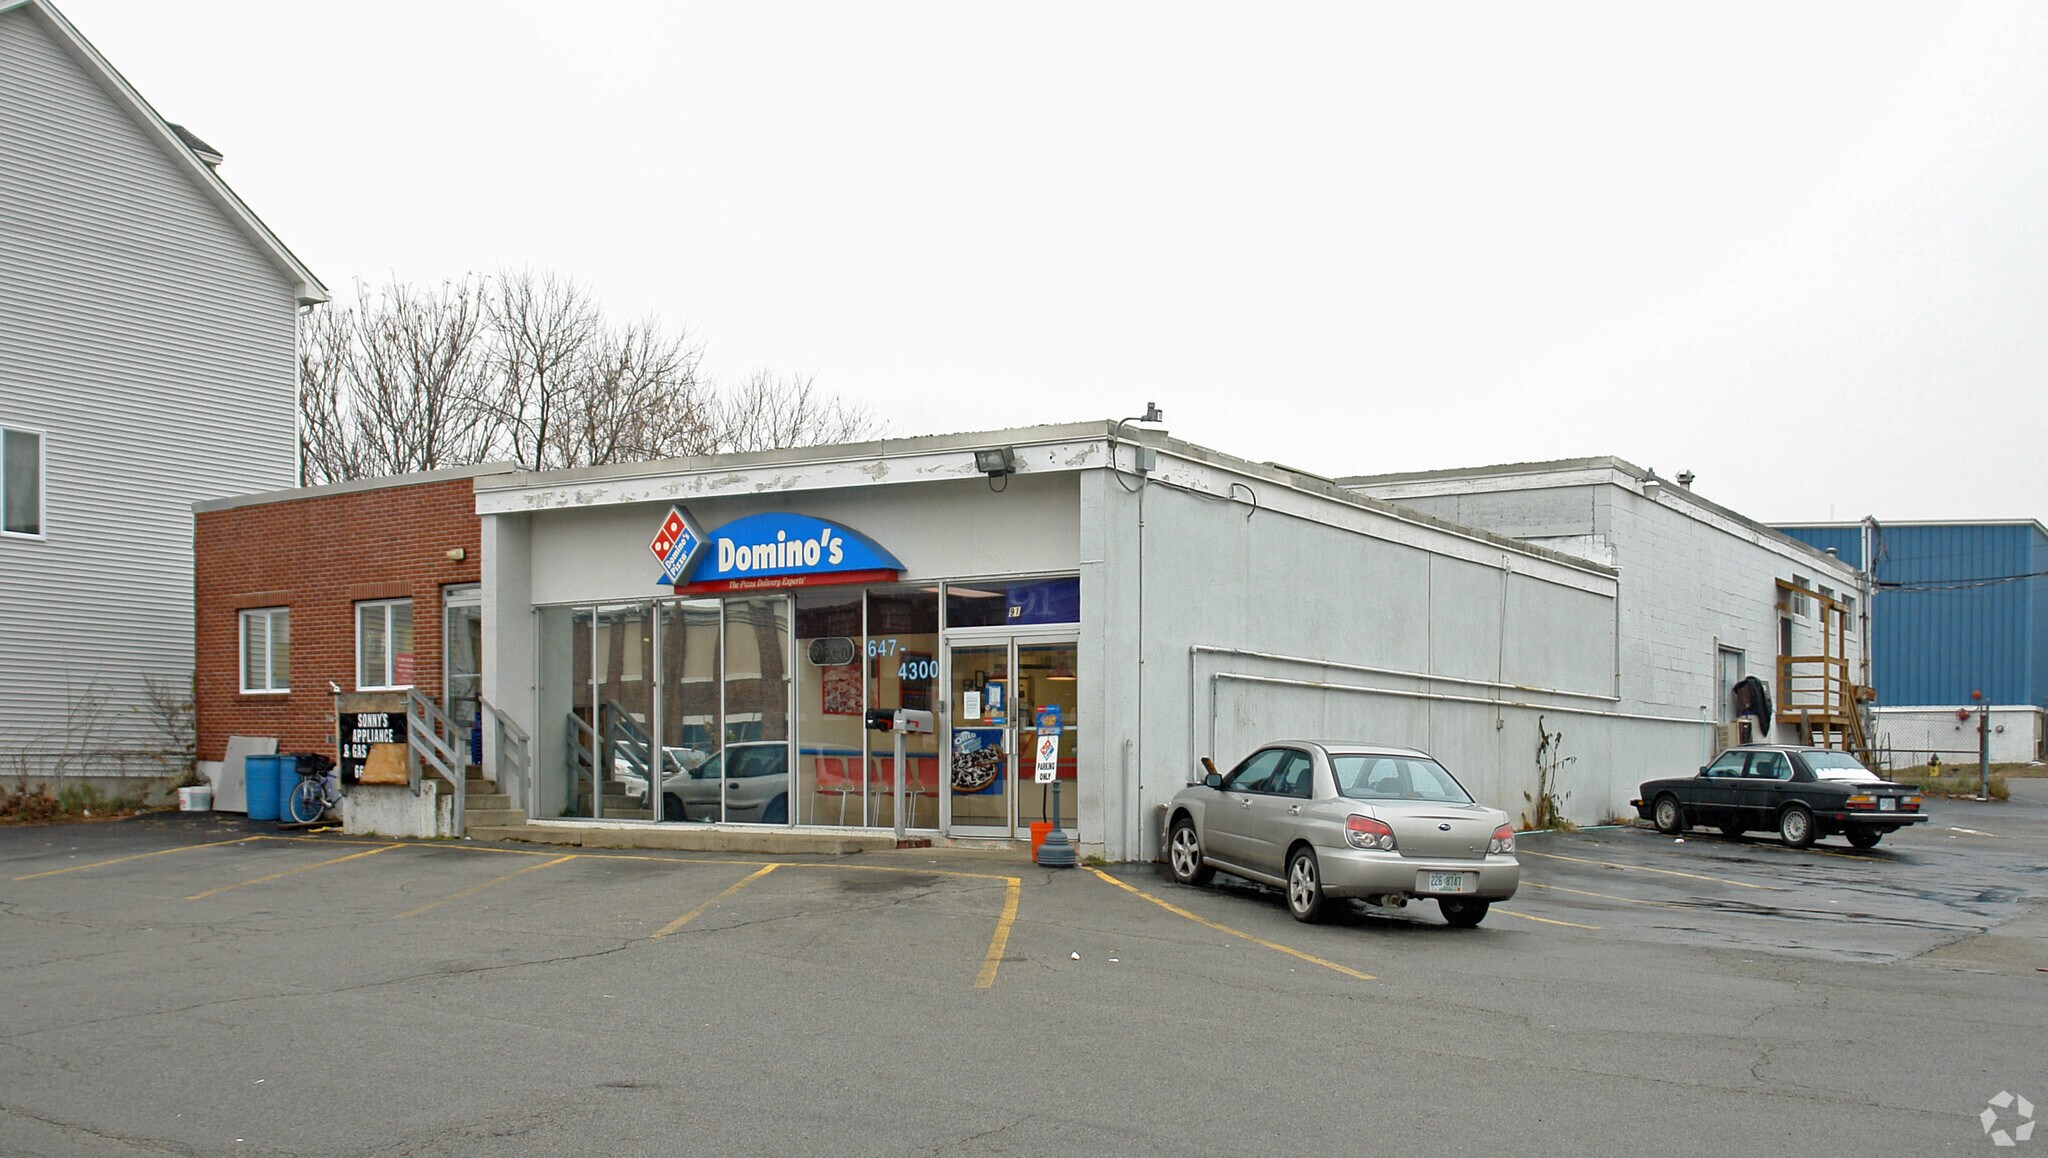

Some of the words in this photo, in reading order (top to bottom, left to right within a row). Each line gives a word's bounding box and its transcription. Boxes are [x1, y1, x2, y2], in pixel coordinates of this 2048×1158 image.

[664, 532, 690, 569] Domino's
[718, 528, 844, 573] Domino's
[670, 552, 687, 576] Pizza
[729, 580, 739, 589] The
[740, 579, 756, 588] Pizza
[757, 578, 781, 587] Delivery
[1009, 607, 1020, 617] 91
[867, 639, 906, 657] 647-
[898, 660, 939, 680] 4300
[357, 713, 389, 728] SONNY'S
[352, 728, 394, 743] APPLIANCE
[343, 743, 350, 758] &
[352, 743, 367, 759] GAS
[1037, 762, 1055, 770] PARKING
[1039, 772, 1052, 781] ONLY
[1430, 875, 1443, 886] 226
